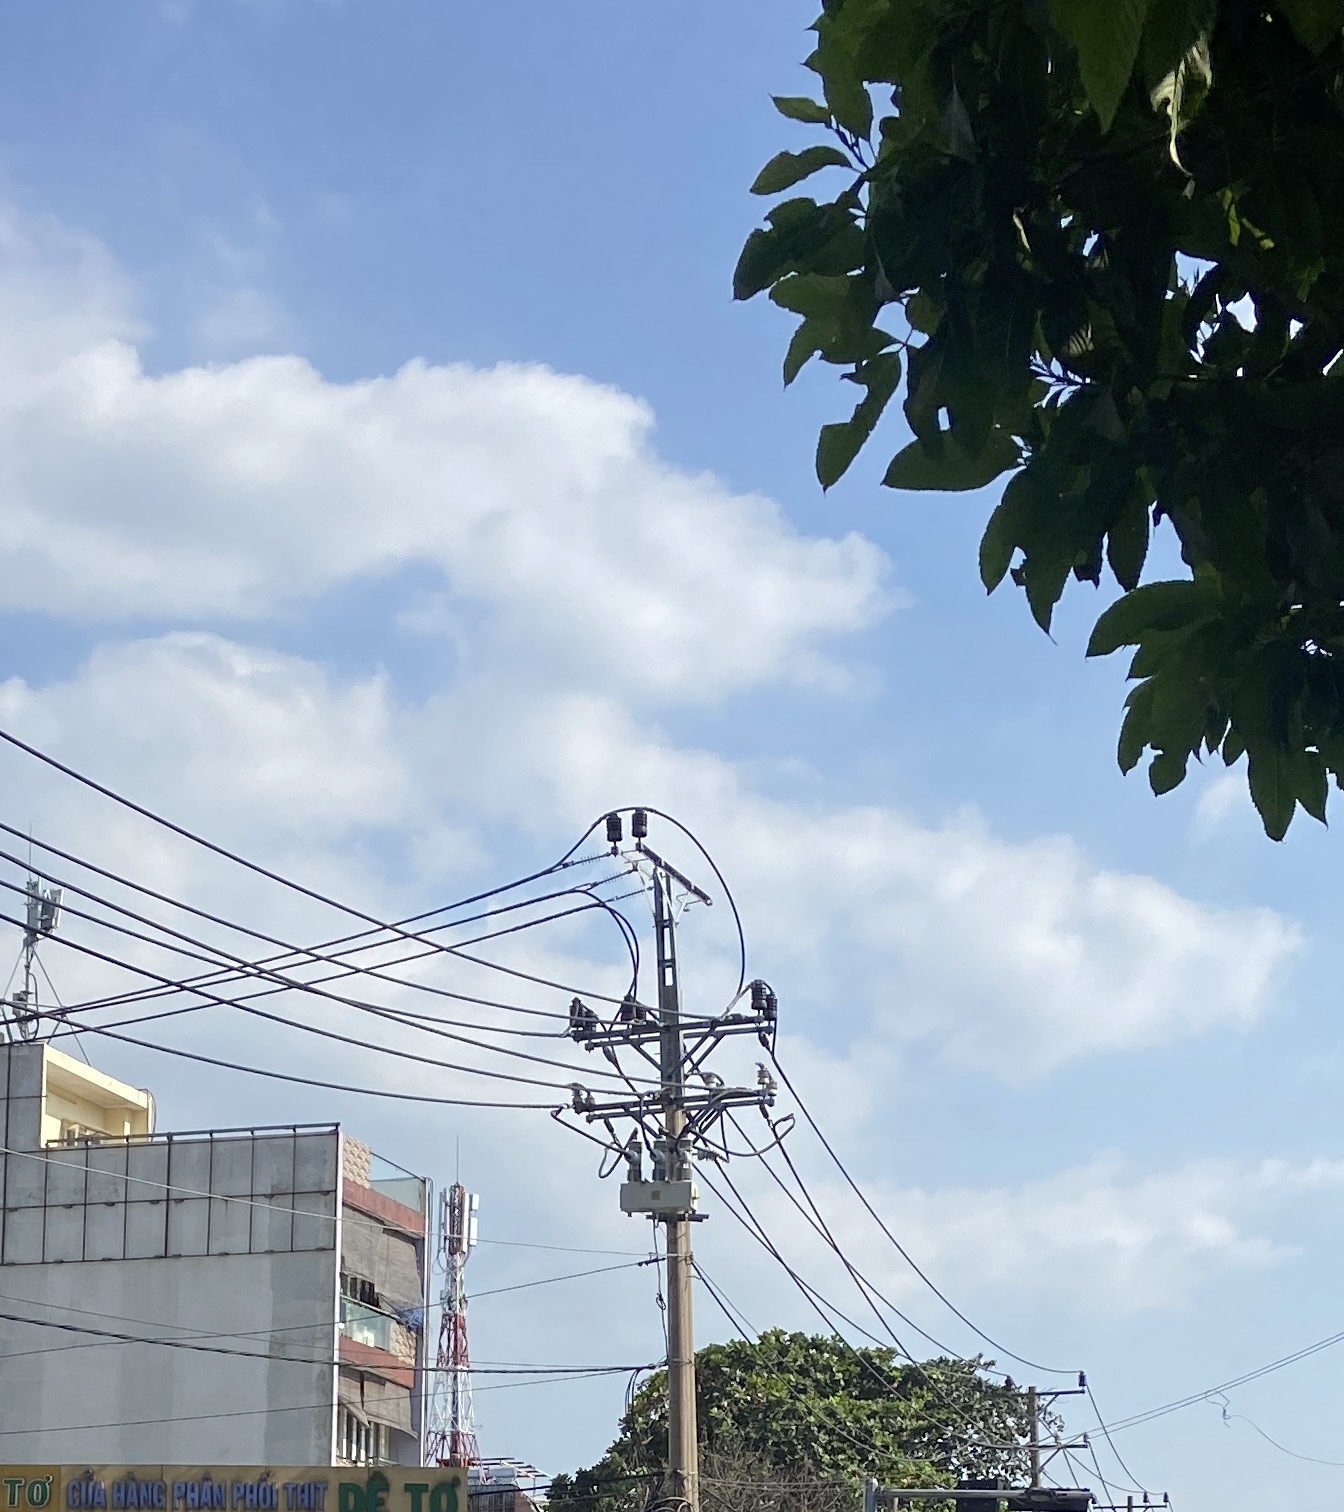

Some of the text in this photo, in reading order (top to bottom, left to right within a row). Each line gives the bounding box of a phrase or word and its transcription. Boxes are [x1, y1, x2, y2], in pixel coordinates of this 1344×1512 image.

[4, 1475, 53, 1508] TƠ
[66, 1468, 107, 1510] CỬA
[111, 1471, 167, 1511] HÀNG
[172, 1471, 227, 1511] PHÂN
[231, 1469, 277, 1511] PHỐI
